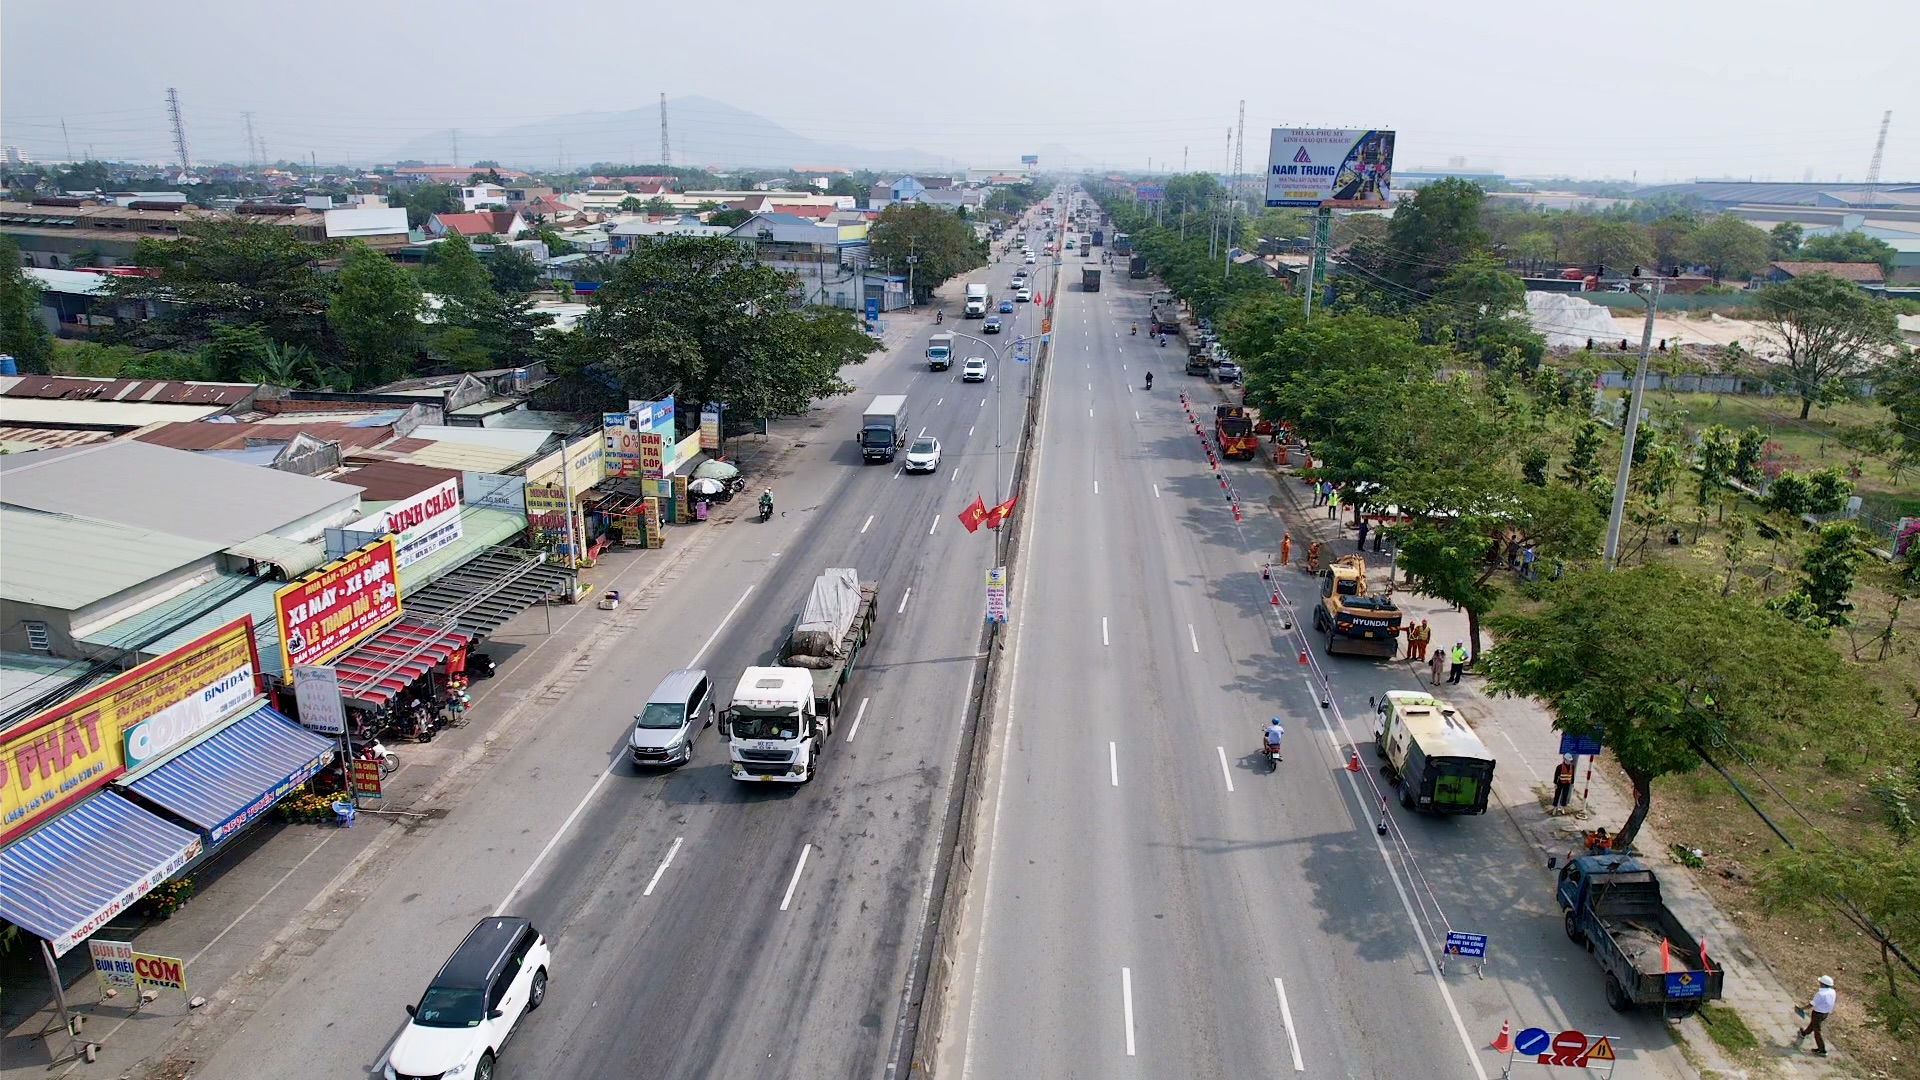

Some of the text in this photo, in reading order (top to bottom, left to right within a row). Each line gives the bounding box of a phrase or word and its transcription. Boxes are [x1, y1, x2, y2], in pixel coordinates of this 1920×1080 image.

[1272, 165, 1336, 176] NAM TRUNG
[387, 487, 457, 533] MINH CHÂU
[305, 581, 321, 595] MUA
[339, 562, 357, 577] TRAO
[288, 559, 390, 628] XE MÁY XE ĐIỆN
[380, 601, 392, 613] CAO
[1353, 617, 1389, 627] HYUNDAI
[305, 621, 320, 646] LÊ
[302, 711, 336, 723] VANG
[71, 920, 94, 943] NGỌC
[92, 943, 132, 959] BÚN BÒ
[1460, 946, 1481, 955] 5km/h
[95, 957, 114, 972] BÚN
[135, 957, 182, 983] CƠM
[140, 977, 180, 989] TRƯA
